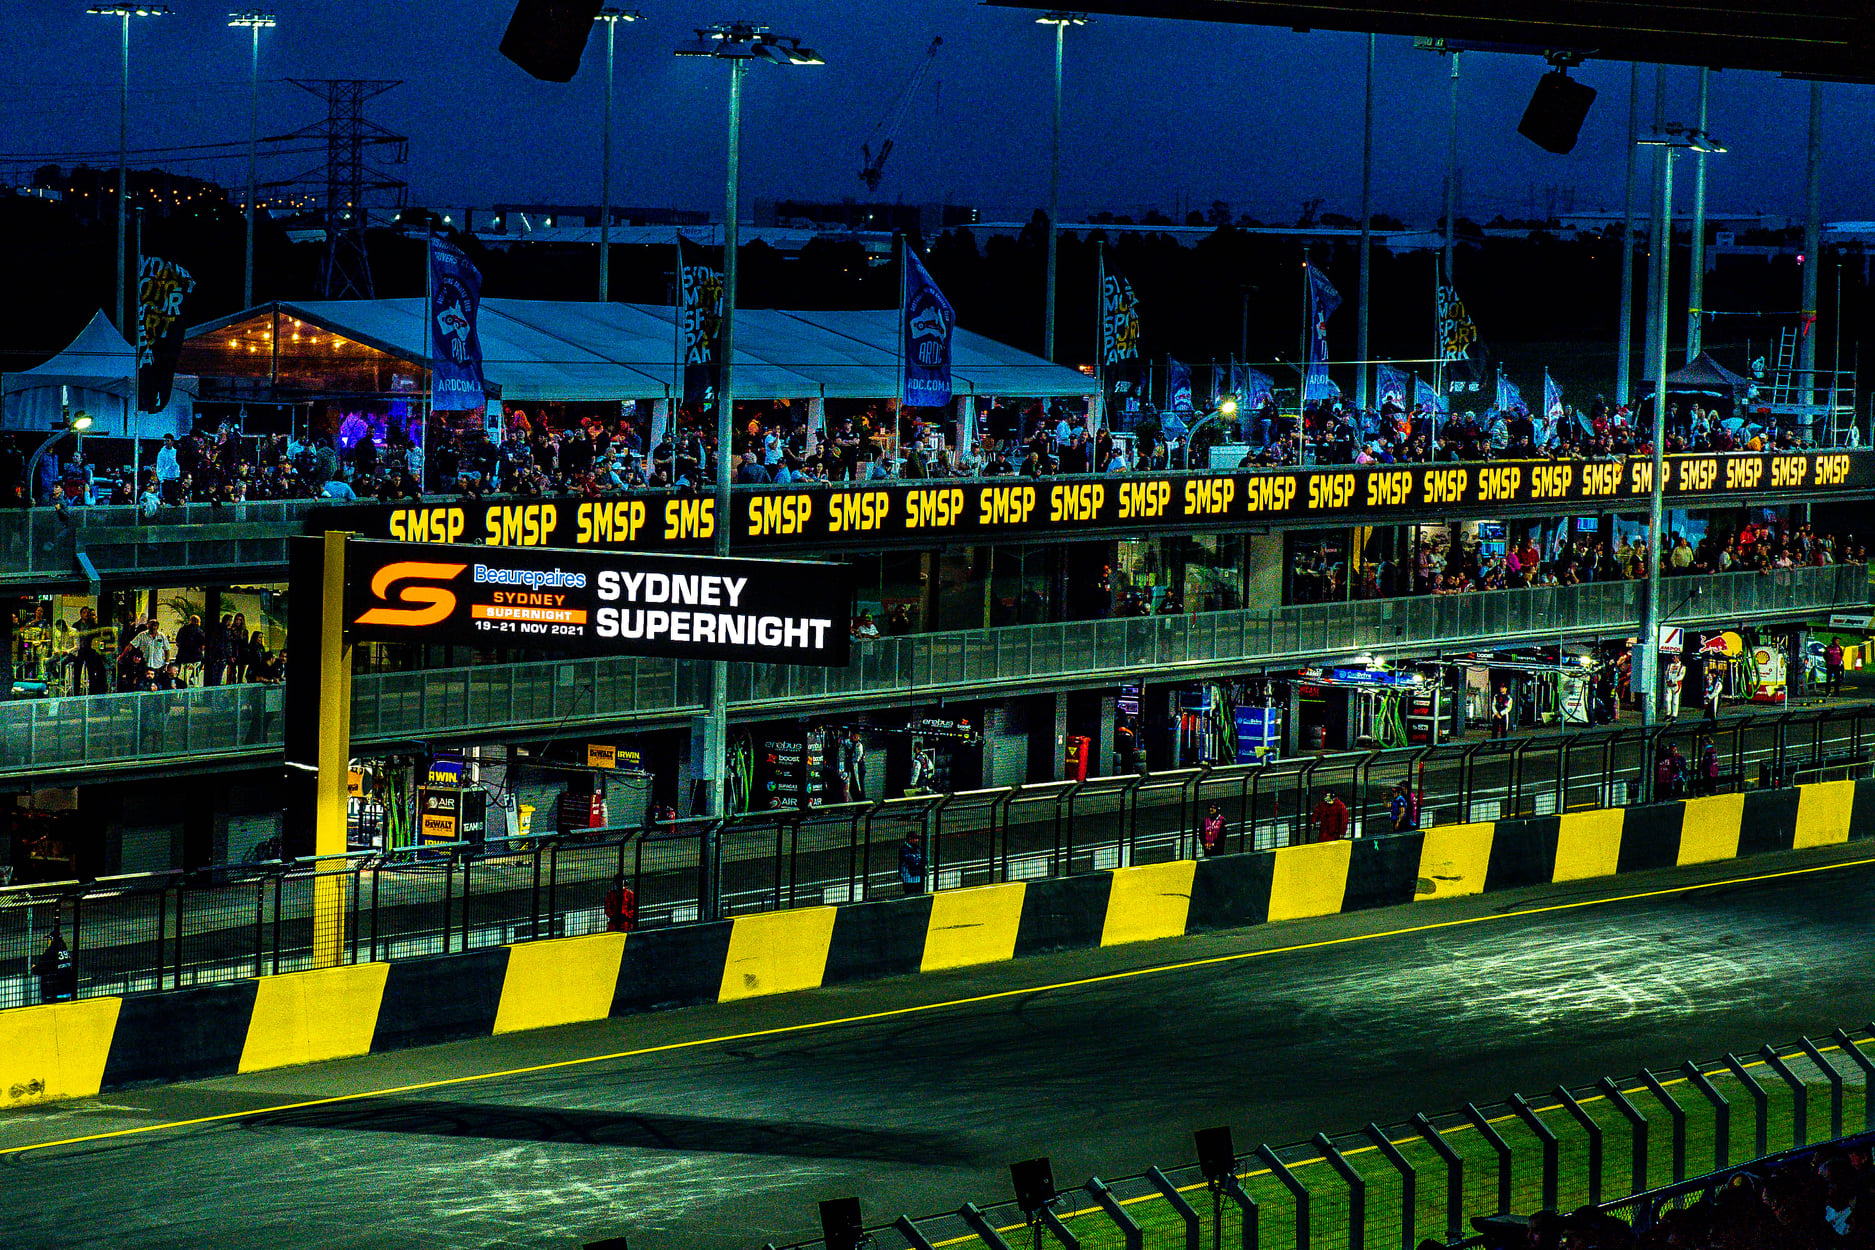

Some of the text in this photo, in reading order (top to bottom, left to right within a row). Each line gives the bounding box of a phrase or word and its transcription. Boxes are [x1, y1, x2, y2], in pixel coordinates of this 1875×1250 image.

[1423, 469, 1468, 503] SMSP
[1478, 467, 1521, 501] SMSP
[1531, 465, 1572, 498] SMSP
[1582, 463, 1624, 496] SMSP
[1631, 461, 1671, 494] SMP
[1679, 459, 1718, 491] SMSP
[1726, 457, 1763, 489] SMSP
[1771, 456, 1807, 487] SMSP
[1814, 454, 1850, 485] SMSP
[979, 486, 1036, 525] SMSP
[1050, 484, 1105, 522] SMSP
[1118, 480, 1171, 518] SMSP
[1184, 478, 1235, 515] SMSP
[1247, 476, 1297, 512] SMSP
[1308, 473, 1356, 509] SMSP
[1367, 471, 1413, 506] SMSP
[390, 507, 465, 542] SMSP
[486, 504, 557, 547] SMSP
[577, 500, 646, 544] SMSP
[664, 498, 715, 540] SMS
[748, 494, 812, 536] SMSP
[829, 491, 889, 532] SMSP
[905, 488, 964, 528] SMSP
[473, 563, 587, 591] Beaurepaires
[597, 570, 748, 607] SYDNEY
[485, 607, 573, 622] SUPERNIGHT
[493, 591, 566, 607] SYDNEY
[474, 620, 584, 636] 19-21 NOV 2021
[595, 607, 832, 649] SUPERNIGHT
[438, 797, 455, 807] AIR
